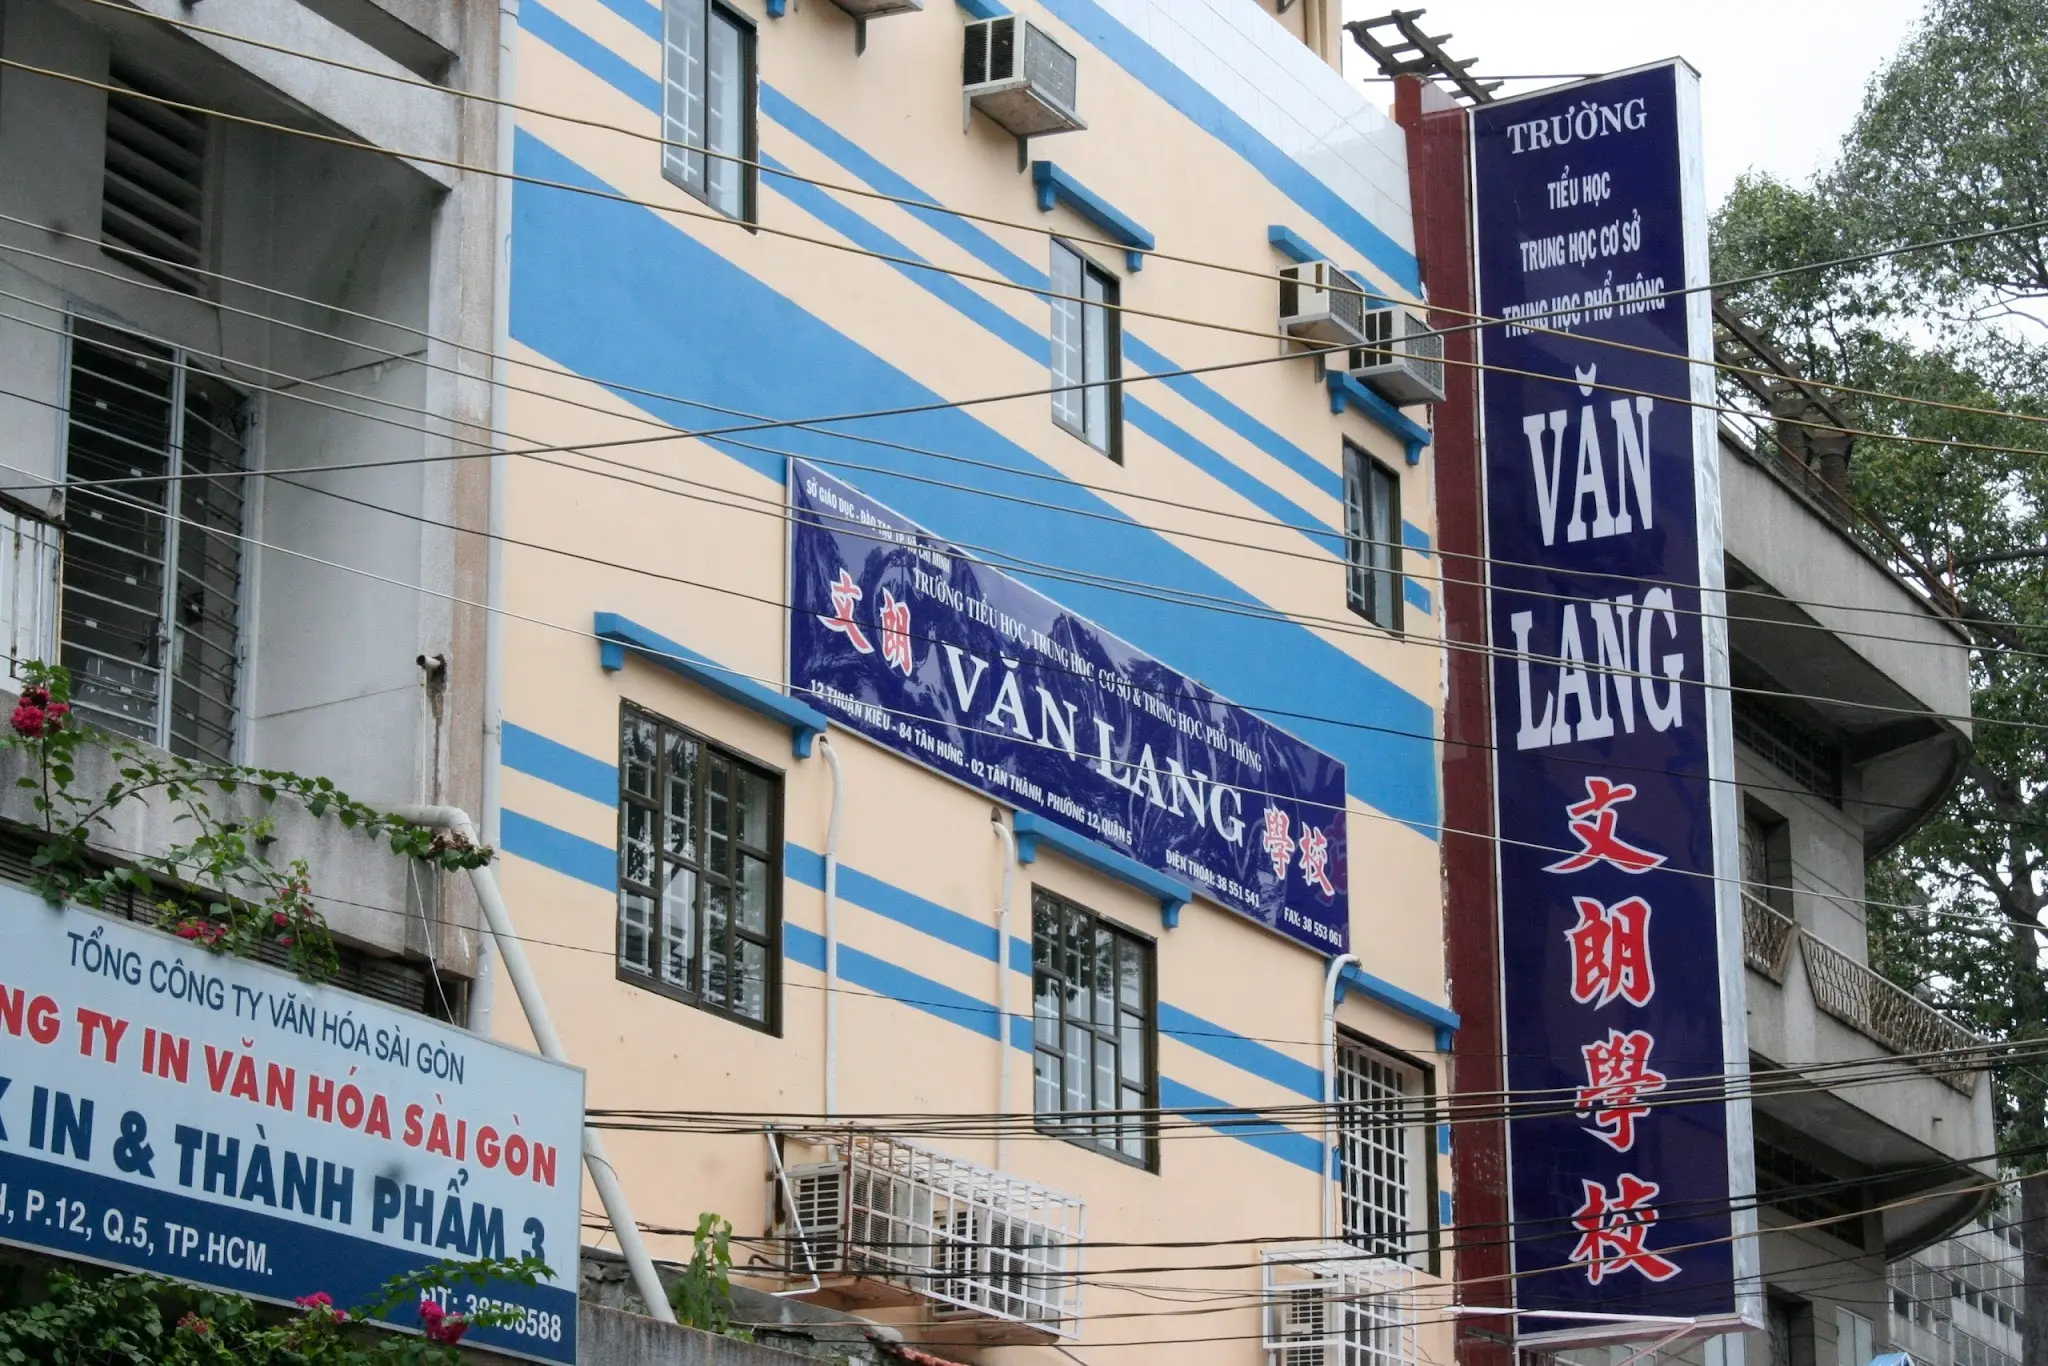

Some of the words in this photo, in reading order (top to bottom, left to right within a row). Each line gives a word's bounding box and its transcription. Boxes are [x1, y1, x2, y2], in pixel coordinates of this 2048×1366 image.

[1507, 98, 1647, 154] TRƯỜNG
[1547, 165, 1578, 209] TIỂU
[1582, 172, 1610, 207] HỌC
[1520, 235, 1565, 272] TRUNG
[1569, 229, 1596, 267] HỌC
[1600, 219, 1619, 257] CƠ
[1622, 208, 1641, 252] SỞ
[1502, 299, 1548, 338] TRUNG
[1551, 293, 1581, 333] HỌC
[1584, 269, 1613, 323] PHỔ
[1616, 272, 1665, 316] THÔNG
[806, 477, 818, 498] SỞ
[819, 486, 837, 509] GIÁO
[860, 509, 876, 531] ĐÀO
[1523, 362, 1653, 547] VĂN
[913, 567, 963, 612] TRƯỜNG
[966, 593, 998, 629] TIỂU
[1000, 613, 1030, 649] HỌC,
[1032, 629, 1069, 669] TRUNG
[1070, 653, 1094, 682] HỌC
[1099, 668, 1115, 693] CƠ
[1133, 687, 1141, 708] &
[1142, 692, 1176, 728] TRUNG
[1177, 712, 1203, 740] HỌC
[1206, 722, 1228, 753] PHỔ
[1229, 737, 1262, 773] THÔNG
[1510, 587, 1684, 751] LANG
[810, 679, 824, 699] 12
[827, 686, 862, 718] THUẬN
[899, 722, 912, 742] 84
[914, 727, 935, 753] TÂN
[937, 739, 963, 766] HƯNG
[971, 758, 984, 778] 02
[987, 764, 1008, 788] TÂN
[1009, 774, 1044, 807] THÀNH,
[1047, 792, 1085, 823] PHƯỜNG
[1087, 811, 1101, 834] 12,
[1102, 818, 1126, 841] QUẬN
[1126, 831, 1133, 846] 5
[941, 640, 1078, 761] VĂN
[1092, 716, 1246, 848] LANG
[1166, 849, 1186, 873] ĐIỆN
[1188, 860, 1216, 886] THOẠI:
[1217, 874, 1227, 891] 38
[1228, 881, 1244, 900] 551
[1245, 891, 1260, 908] 541
[1263, 804, 1335, 897] 學校
[1284, 907, 1301, 927] FAX:
[1302, 916, 1313, 933] 38
[1313, 922, 1328, 940] 553
[1328, 931, 1342, 948] 061
[67, 926, 142, 985] TỔNG
[150, 958, 224, 1010] CÔNG
[231, 984, 263, 1020] TY
[269, 992, 316, 1038] VĂN
[322, 1010, 370, 1056] HÓA
[375, 1025, 410, 1068] SÀI
[416, 1040, 464, 1084] GÒN
[1541, 775, 1683, 1286] 文朗學校
[76, 1006, 130, 1064] TY
[142, 1027, 190, 1084] IN
[203, 1036, 296, 1112] VĂN
[307, 1066, 392, 1141] HÓA
[403, 1093, 467, 1162] SÀI
[475, 1114, 556, 1187] GÒN
[25, 1188, 92, 1242] P.12,
[103, 1208, 155, 1256] Q.5,
[164, 1221, 273, 1276] TP.HCM.
[29, 1085, 94, 1161] IN
[113, 1110, 156, 1179] &
[174, 1123, 354, 1225] THÀNH
[372, 1168, 506, 1263] PHẨM
[521, 1217, 546, 1265] 3
